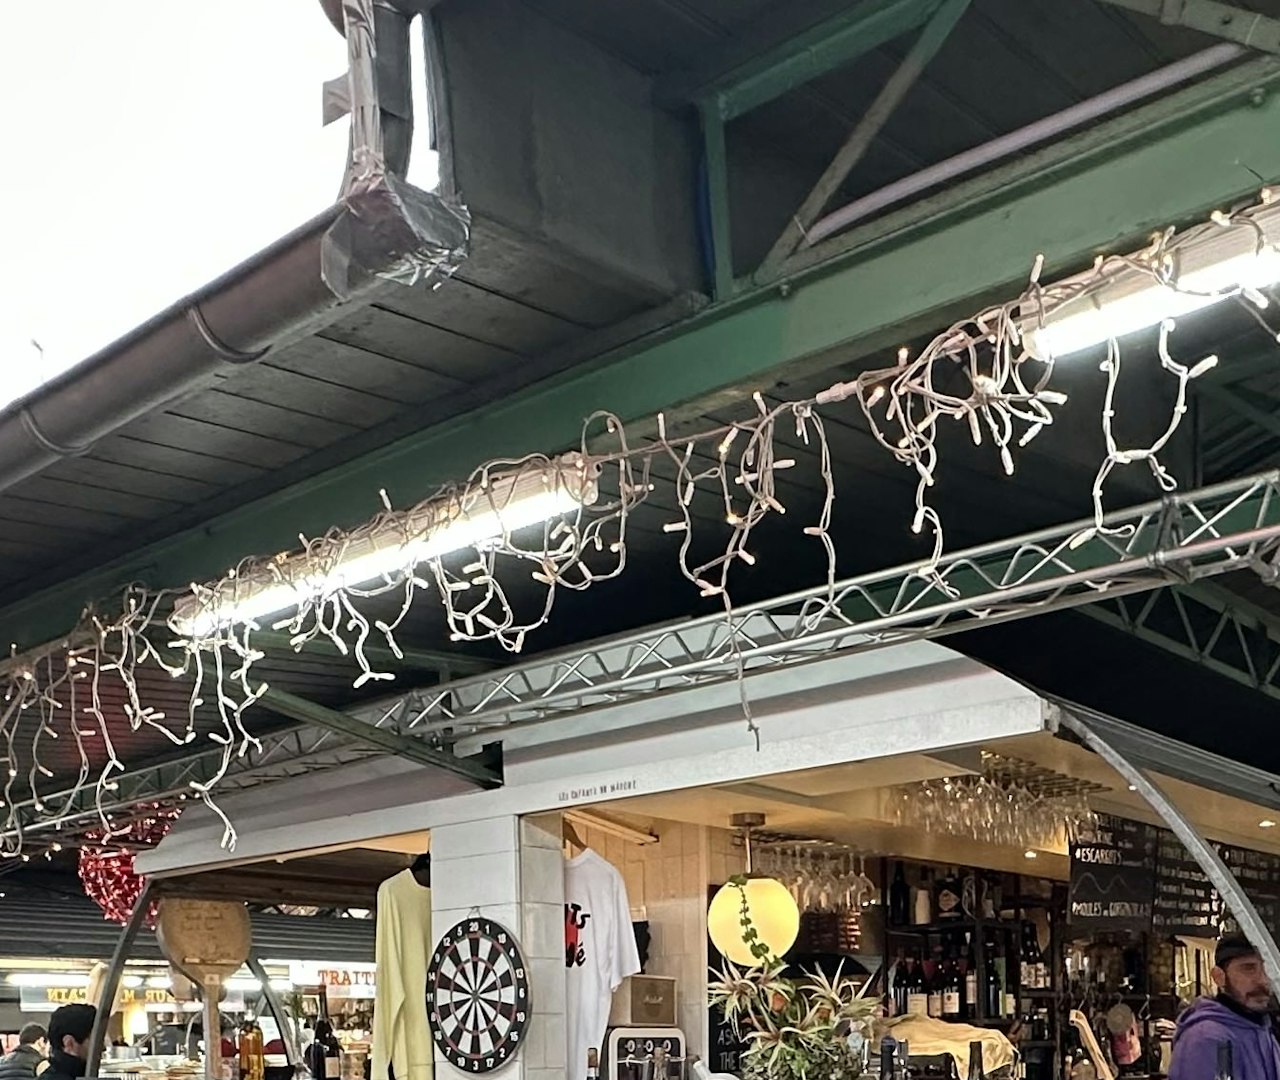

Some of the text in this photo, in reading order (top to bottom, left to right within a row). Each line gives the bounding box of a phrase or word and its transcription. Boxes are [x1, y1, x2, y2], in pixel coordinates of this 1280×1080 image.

[457, 927, 463, 936] 5
[469, 922, 479, 931] 20
[486, 924, 490, 933] 1
[442, 937, 451, 947] 12
[509, 947, 515, 958] 4
[434, 953, 440, 963] 9
[428, 972, 435, 981] 14
[516, 969, 524, 978] 13
[426, 993, 434, 1001] 11
[519, 988, 525, 998] 6
[510, 1031, 519, 1042] 15
[446, 1047, 451, 1056] 7
[500, 1048, 505, 1058] 2
[473, 1061, 479, 1071] 3
[486, 1058, 494, 1068] 17
